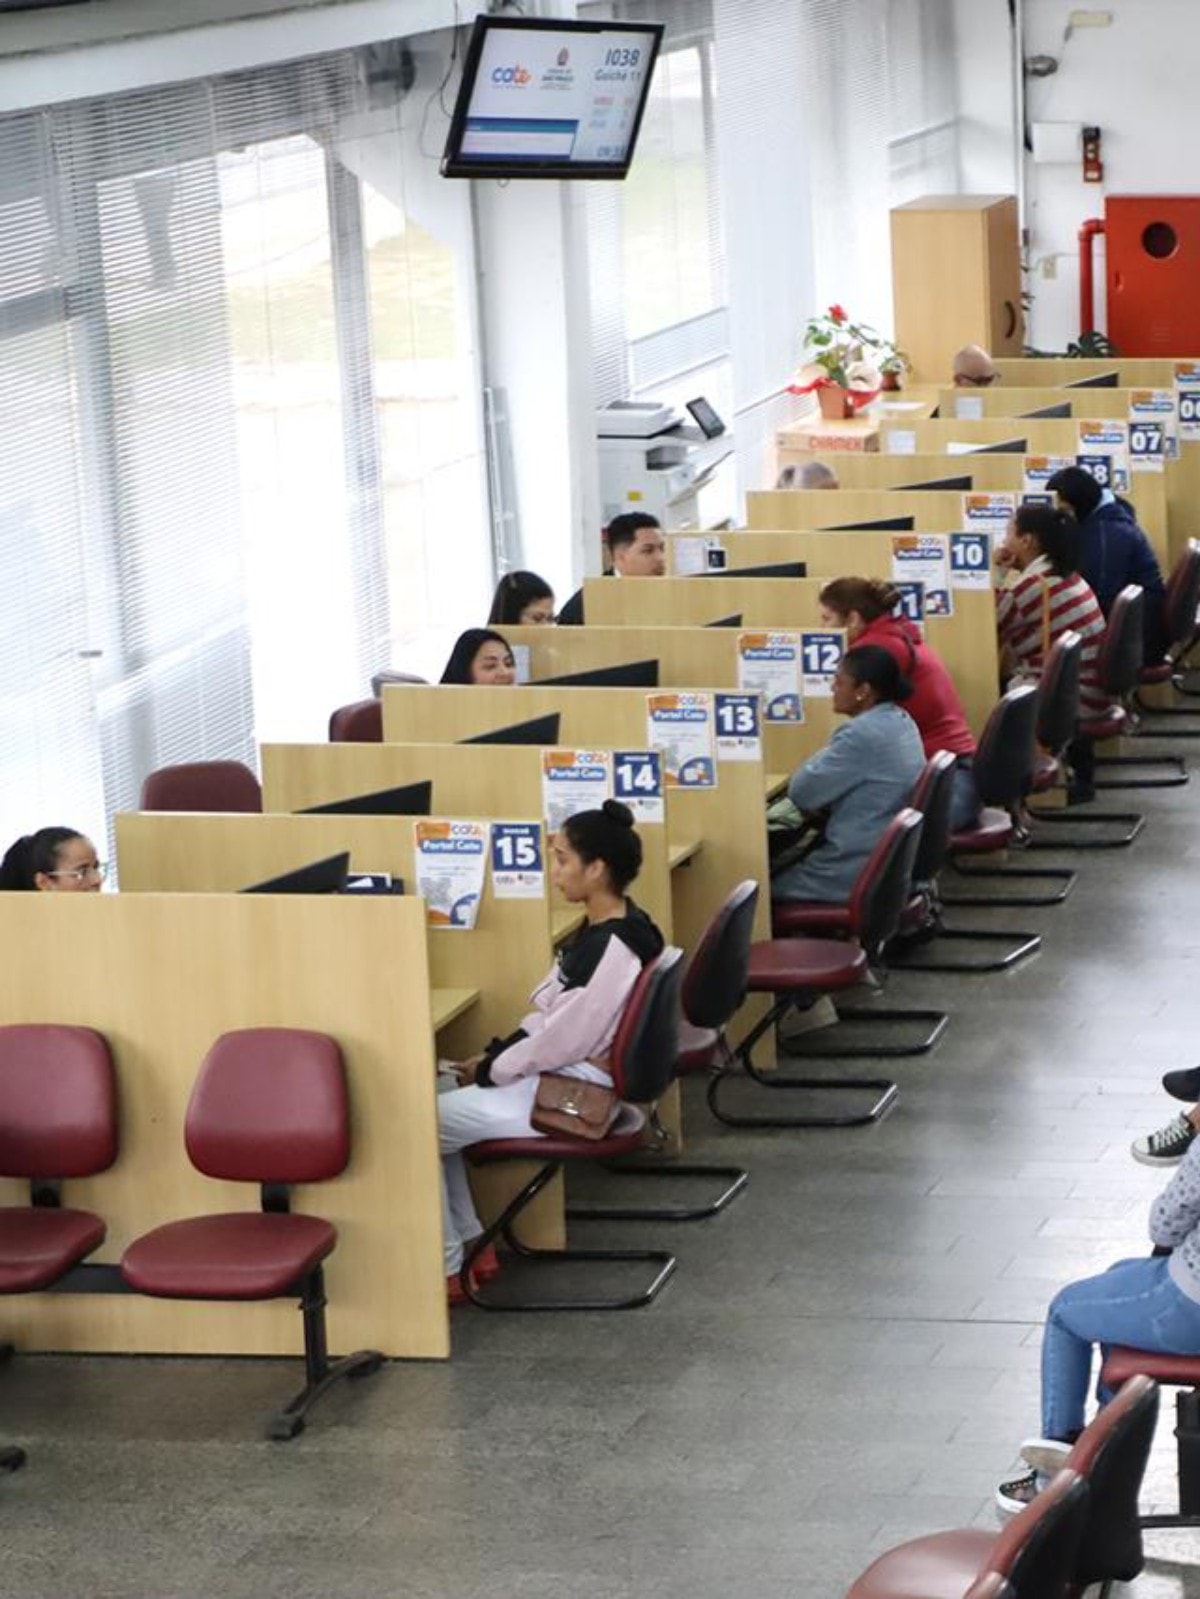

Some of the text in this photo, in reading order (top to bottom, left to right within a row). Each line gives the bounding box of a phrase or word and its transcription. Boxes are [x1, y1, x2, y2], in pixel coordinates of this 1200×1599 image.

[605, 48, 640, 66] 1038
[1132, 431, 1161, 451] 07
[952, 543, 983, 566] 10
[804, 644, 840, 670] 12
[718, 705, 754, 732] 13
[617, 764, 656, 791] 14
[496, 836, 537, 866] 15
